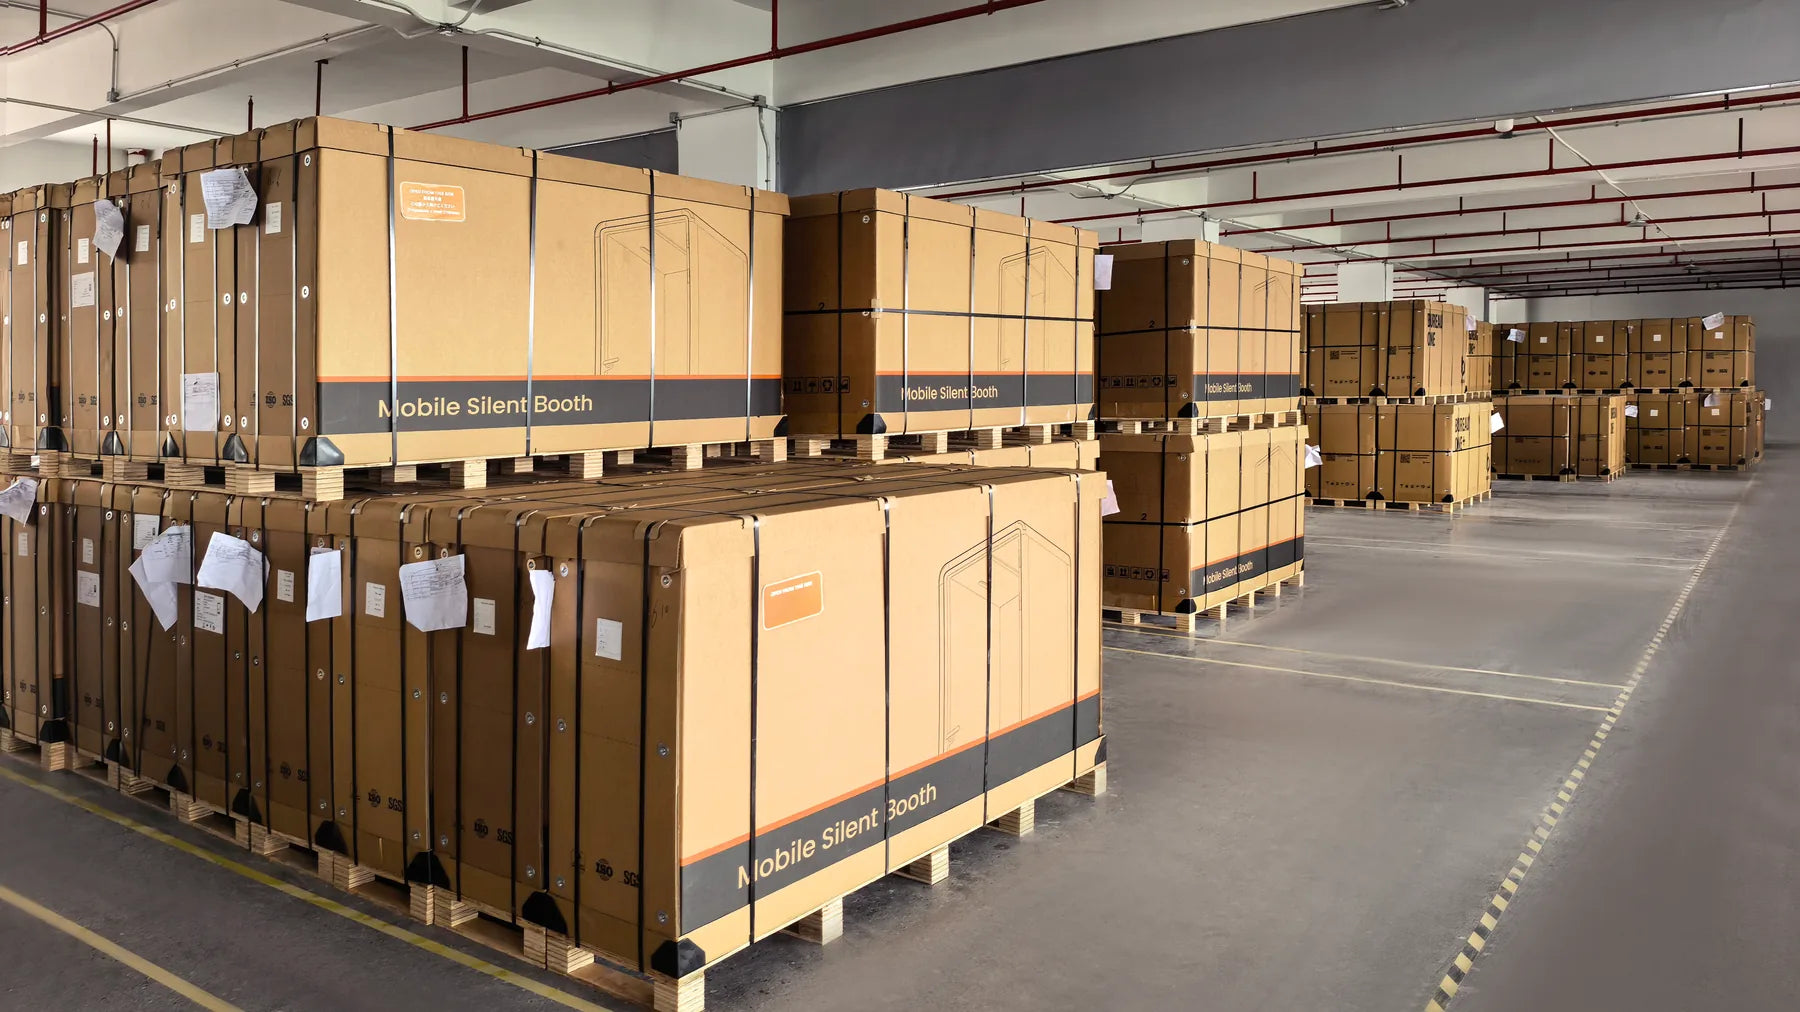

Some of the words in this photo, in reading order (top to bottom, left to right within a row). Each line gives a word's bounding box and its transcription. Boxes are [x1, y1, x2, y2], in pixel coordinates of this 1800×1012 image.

[901, 386, 938, 401] Mobile
[940, 385, 968, 399] Silent
[972, 385, 998, 398] Booth
[1222, 382, 1237, 392] Silent
[378, 397, 460, 418] Mobile
[467, 396, 527, 415] Silent
[534, 394, 593, 413] Booth
[1141, 513, 1148, 521] 2
[737, 839, 816, 889] Mobile
[822, 808, 879, 850] Silent
[883, 782, 937, 822] Booth
